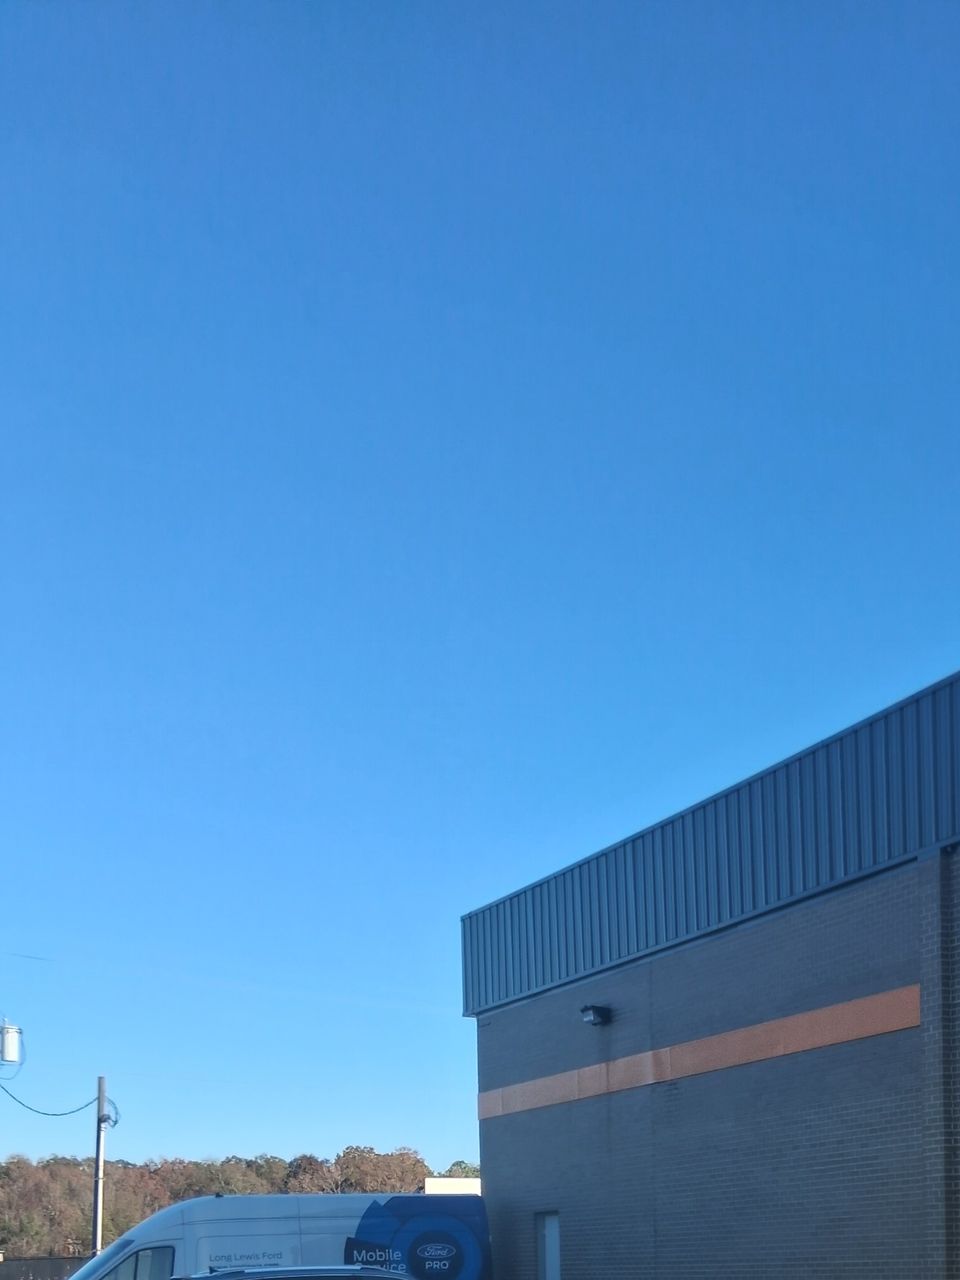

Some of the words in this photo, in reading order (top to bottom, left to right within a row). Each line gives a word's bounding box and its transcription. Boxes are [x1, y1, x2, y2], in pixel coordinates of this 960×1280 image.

[353, 1249, 402, 1262] Mobile
[424, 1245, 449, 1256] Ford
[209, 1253, 232, 1263] Long
[234, 1252, 259, 1261] Lewis
[262, 1251, 283, 1260] Ford
[425, 1260, 450, 1270] PRO
